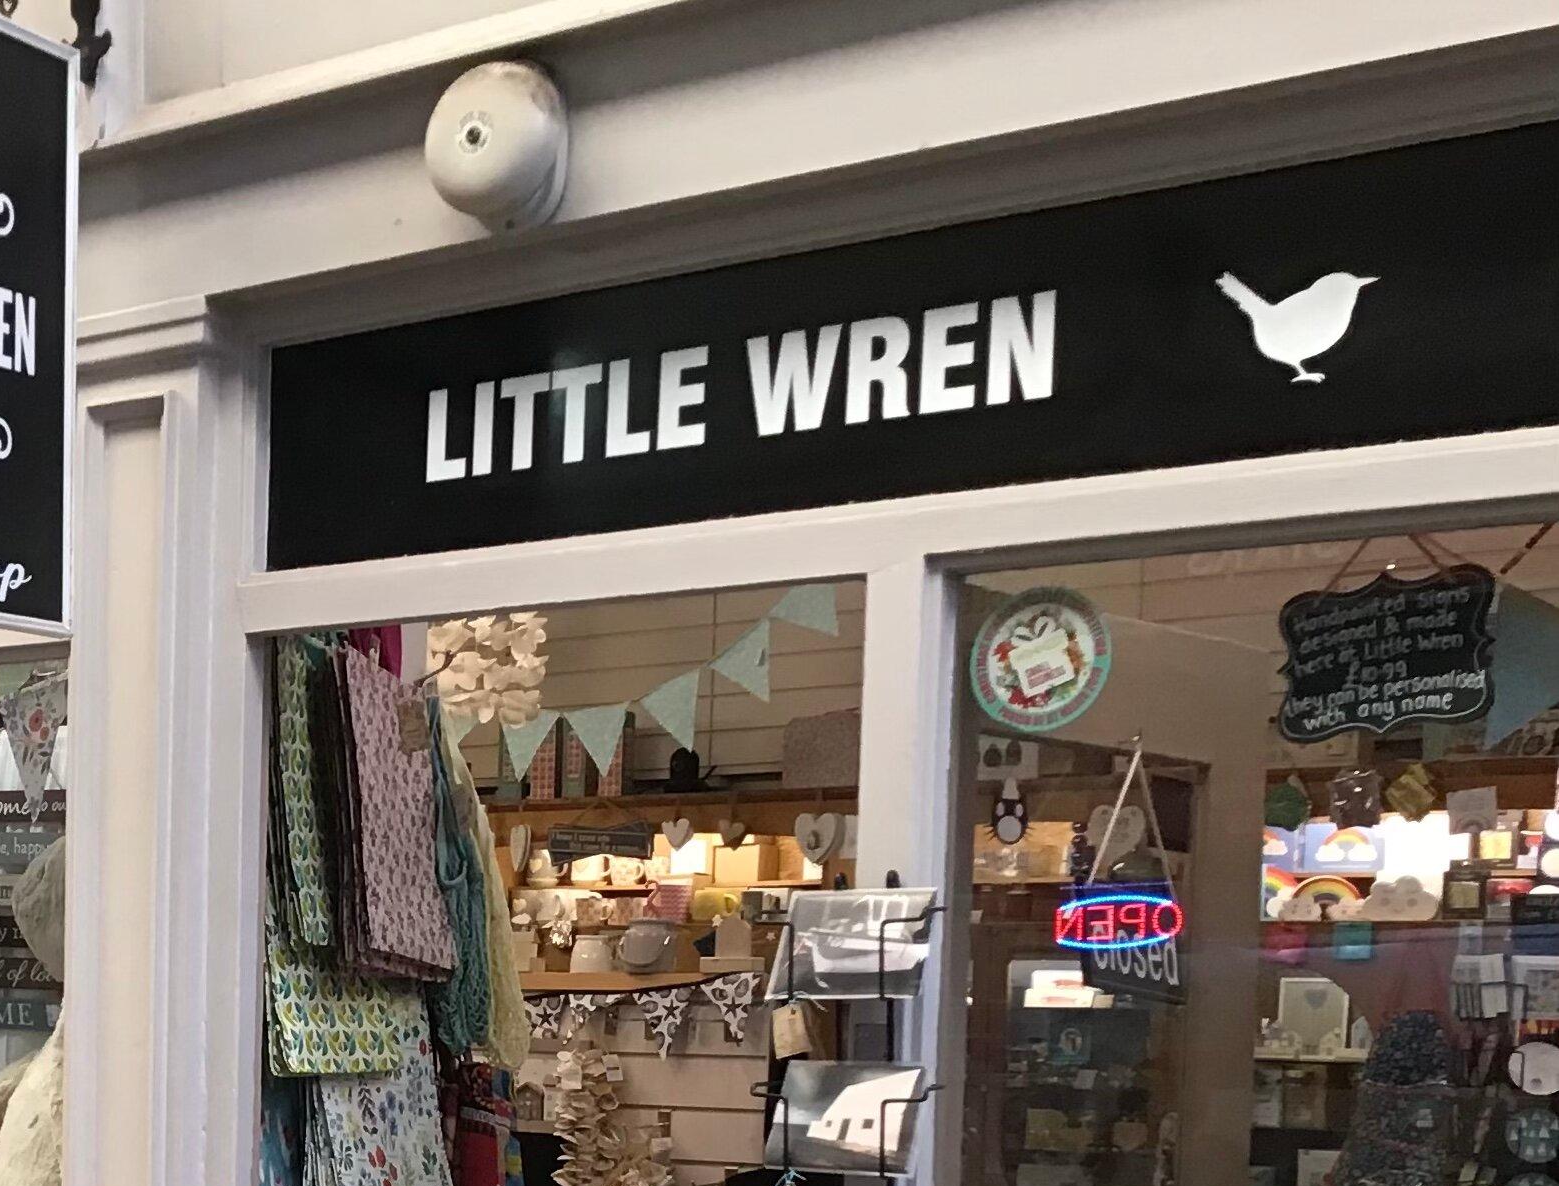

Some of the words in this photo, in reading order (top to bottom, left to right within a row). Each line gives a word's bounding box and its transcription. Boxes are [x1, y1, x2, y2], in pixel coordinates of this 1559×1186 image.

[425, 345, 709, 483] LITTLE
[746, 290, 1057, 438] WREN
[1357, 700, 1395, 721] any
[1401, 692, 1454, 711] name
[7, 960, 28, 987] of
